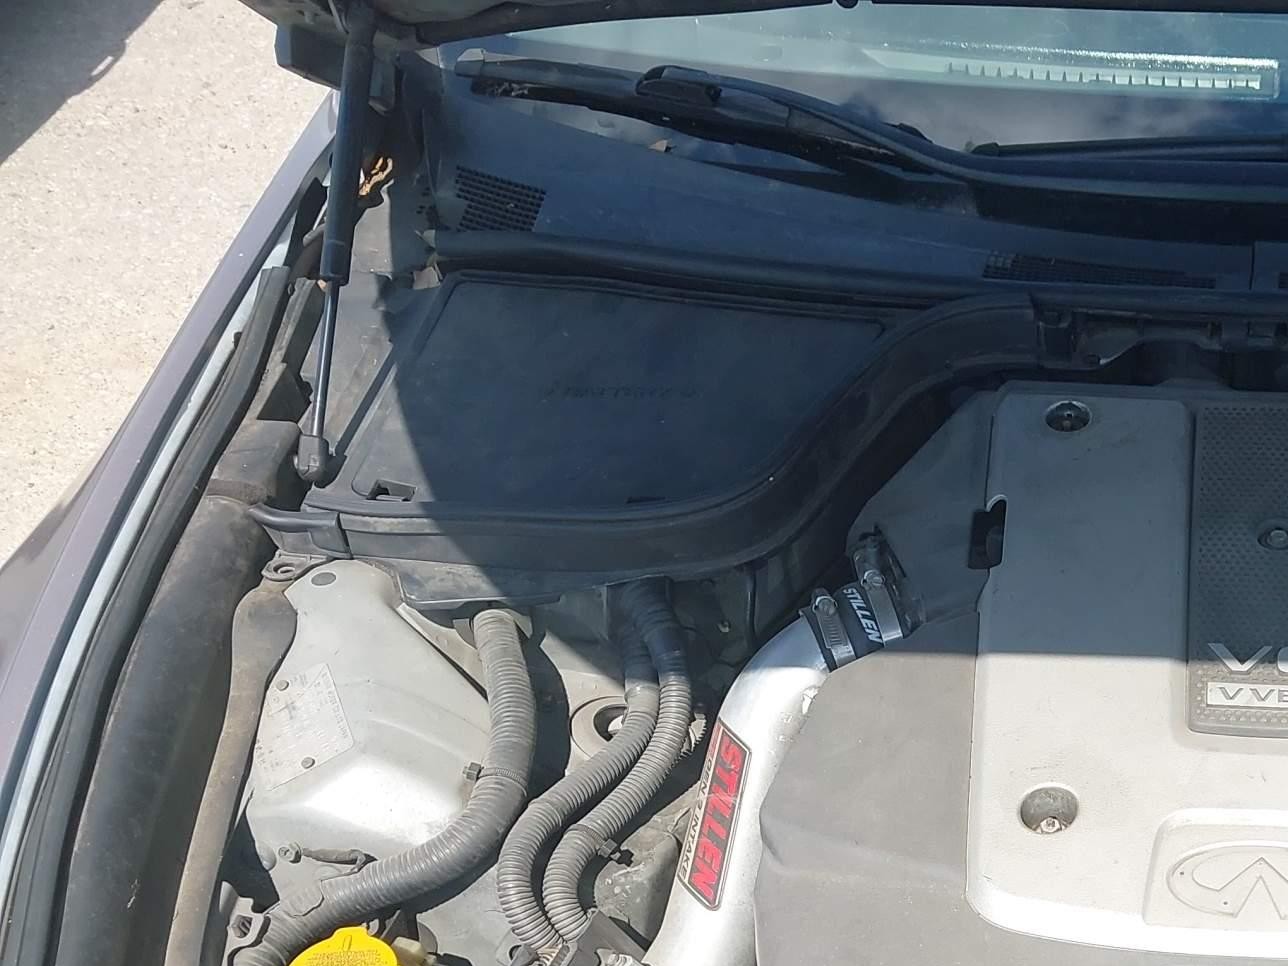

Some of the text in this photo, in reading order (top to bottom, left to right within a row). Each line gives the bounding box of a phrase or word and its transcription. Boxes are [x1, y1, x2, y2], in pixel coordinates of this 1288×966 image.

[842, 587, 883, 644] STILLEN
[679, 805, 700, 882] INTAKE
[690, 733, 744, 903] STILLEN
